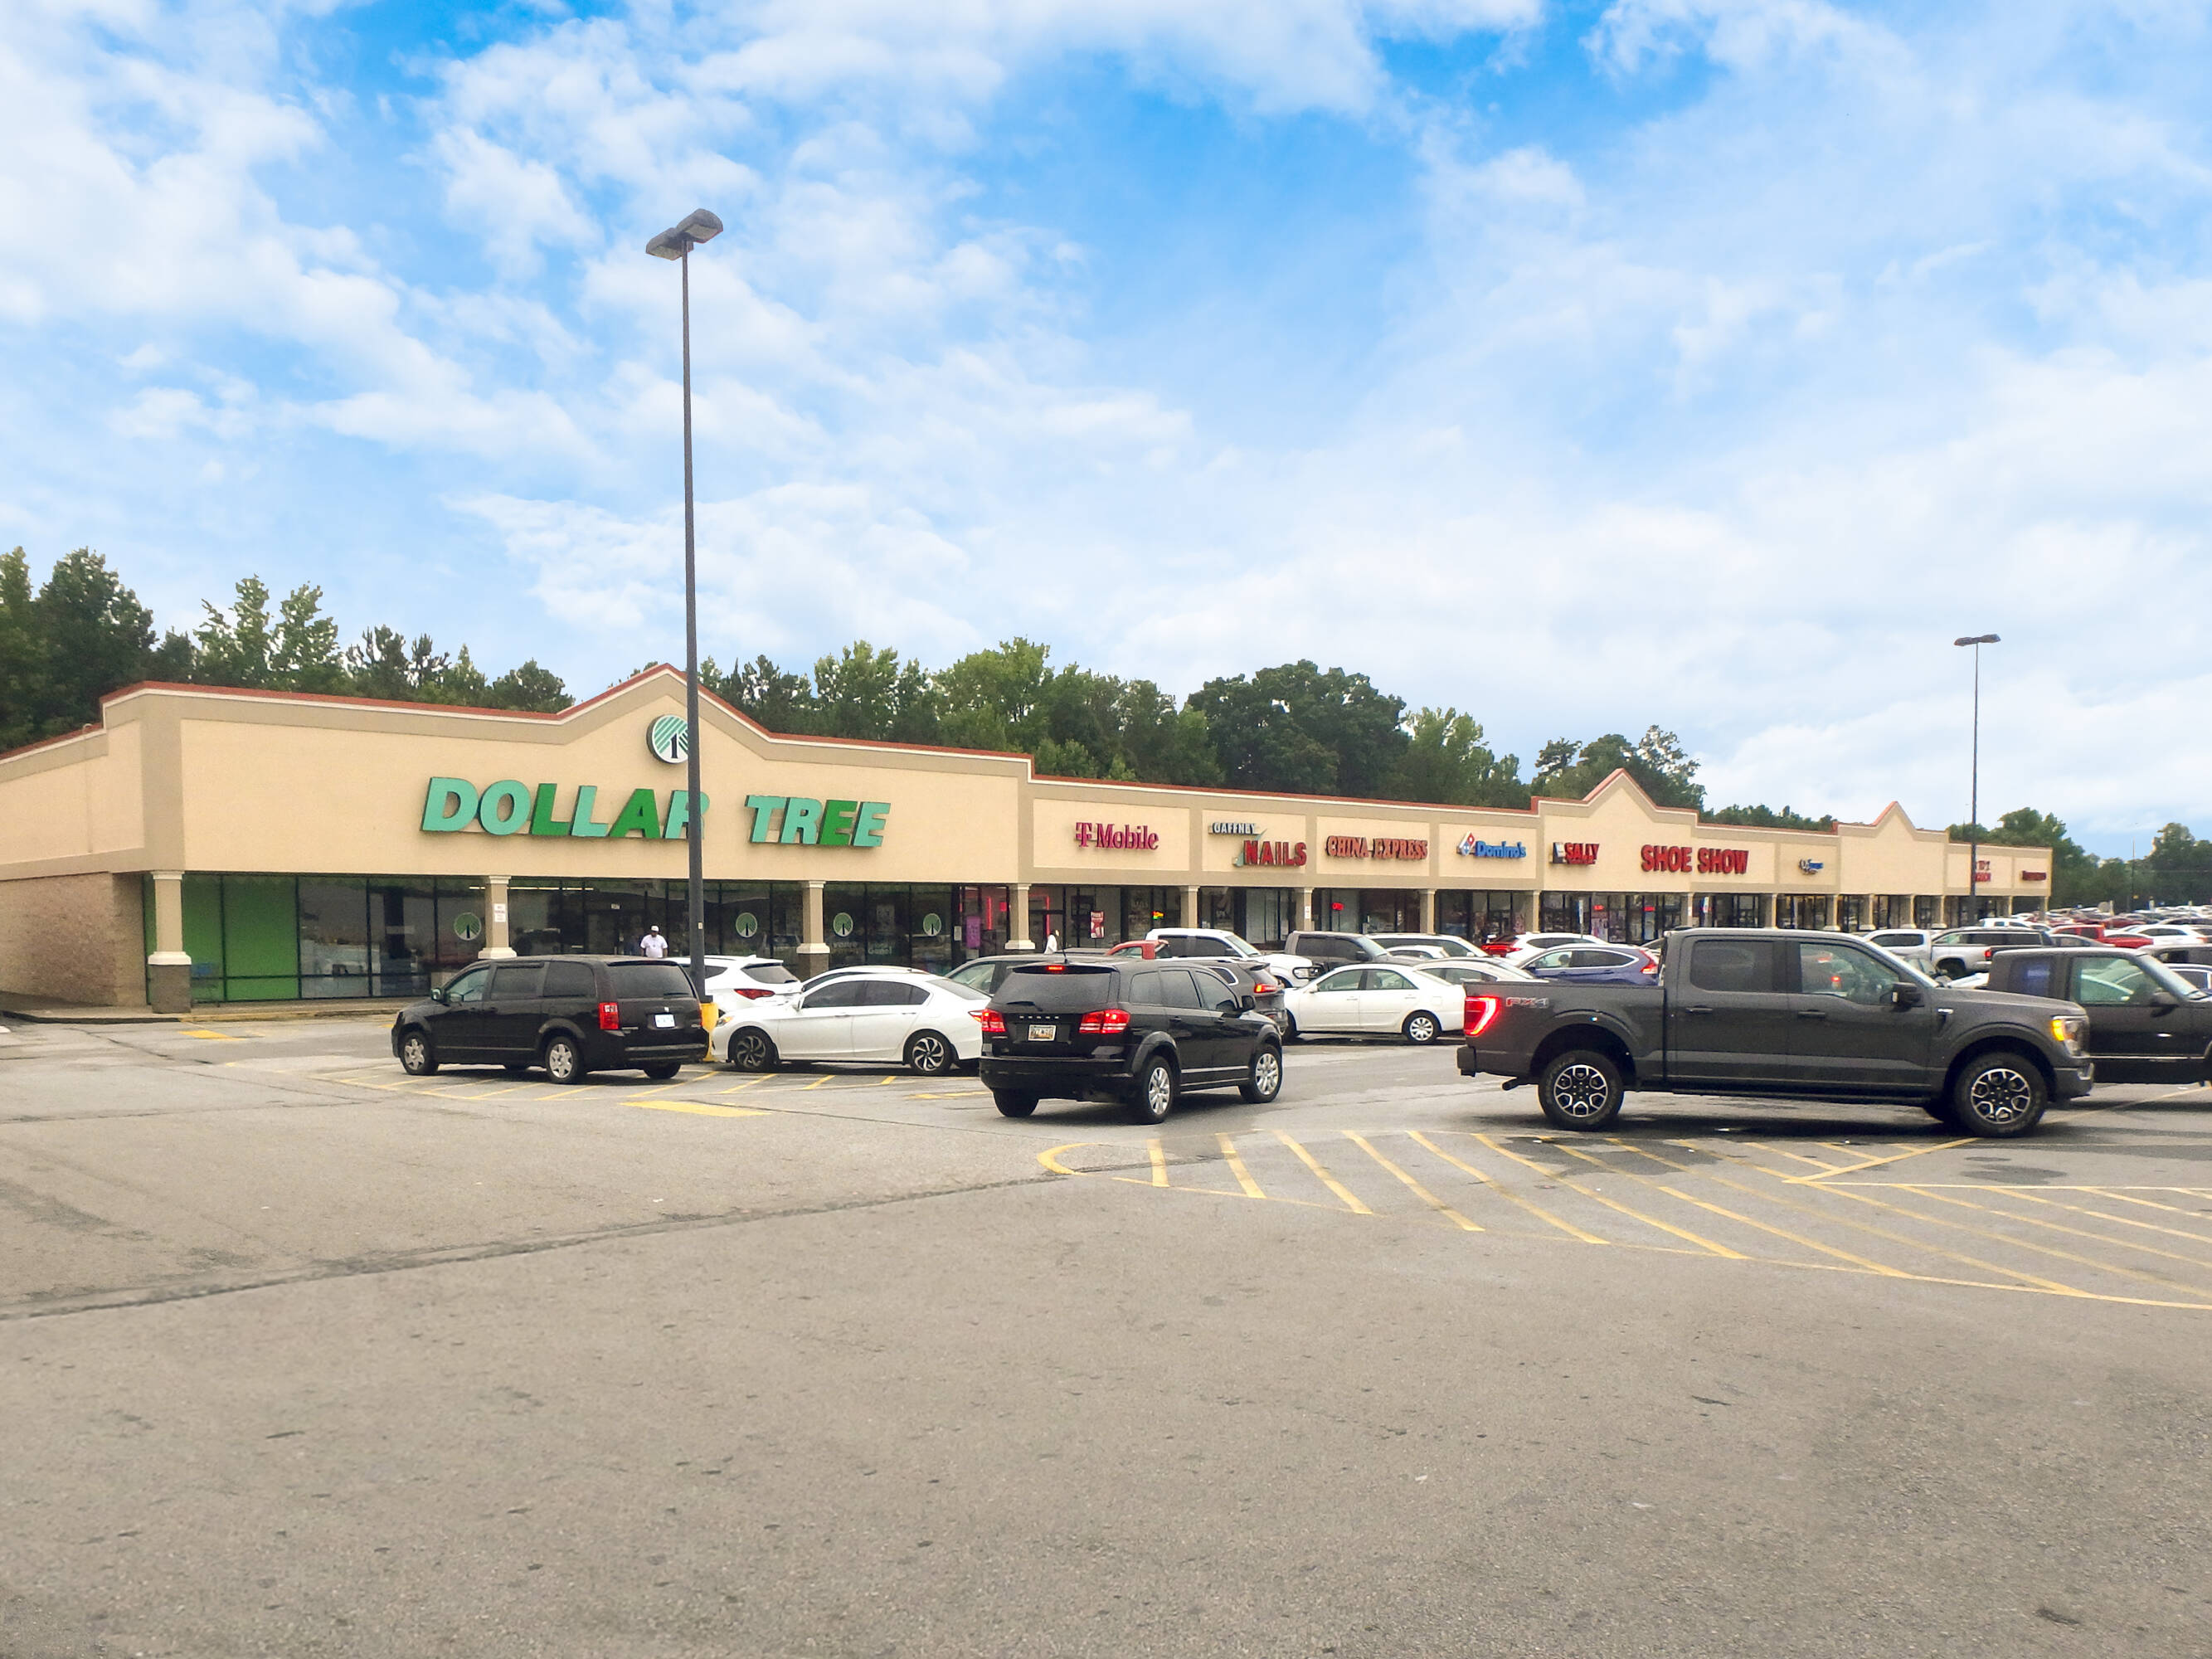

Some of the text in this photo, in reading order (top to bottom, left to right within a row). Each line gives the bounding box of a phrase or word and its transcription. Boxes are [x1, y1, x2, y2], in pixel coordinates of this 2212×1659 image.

[421, 776, 891, 848] DOLLAR TREE
[1212, 822, 1257, 834] GAFFNEY
[1243, 839, 1307, 867] NAILS
[1326, 835, 1427, 859] CHINA EXPRESS
[1475, 840, 1527, 858] Domino's
[1641, 844, 1748, 874] SHOE SHOW
[1505, 997, 1549, 1009] FX4
